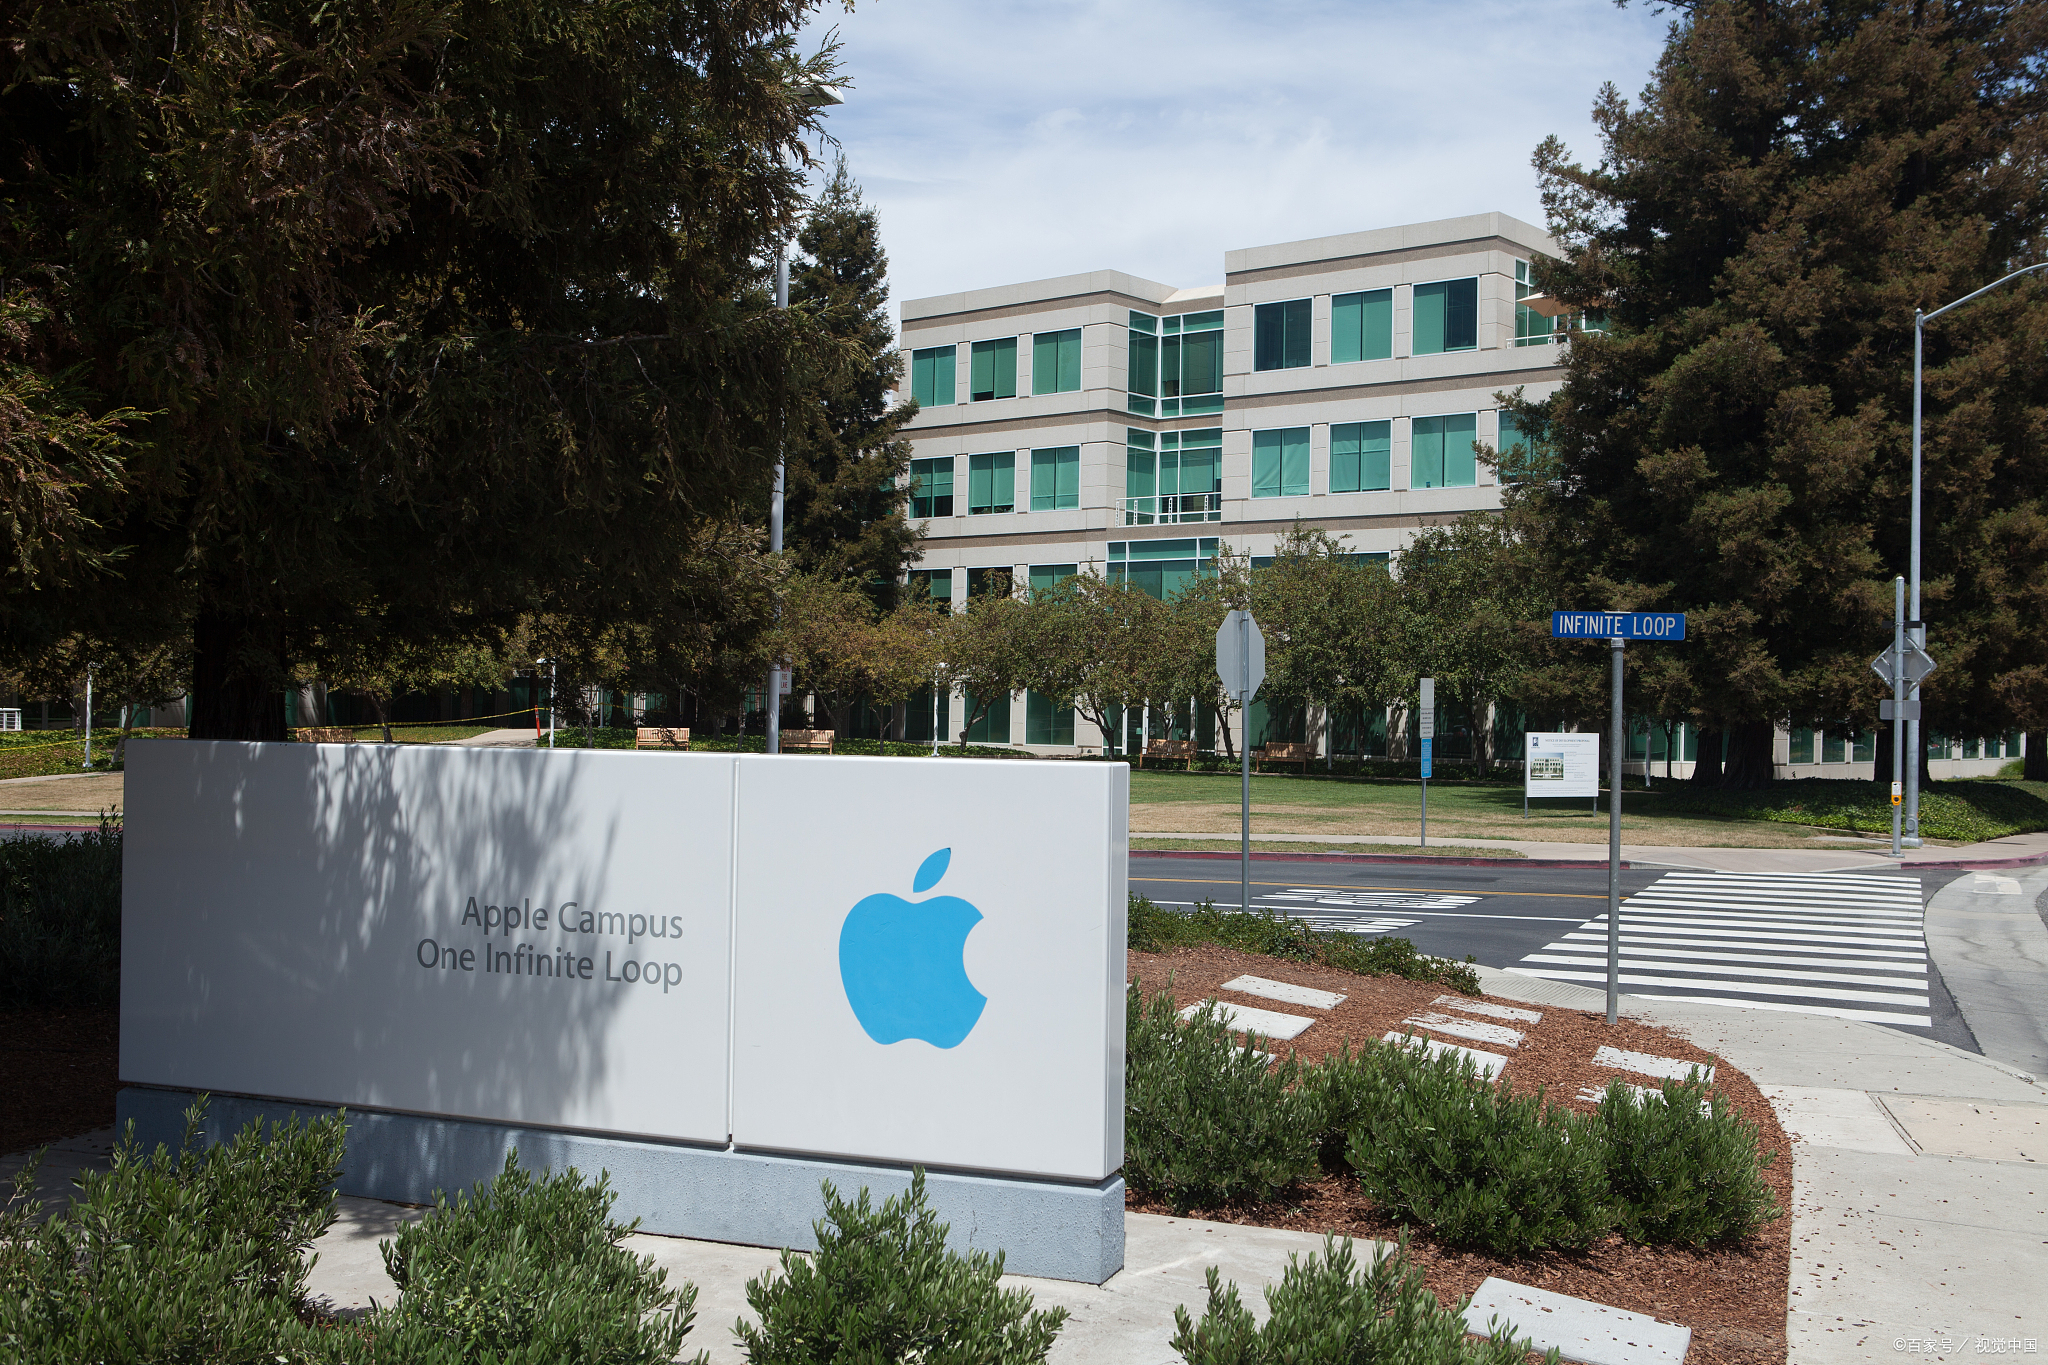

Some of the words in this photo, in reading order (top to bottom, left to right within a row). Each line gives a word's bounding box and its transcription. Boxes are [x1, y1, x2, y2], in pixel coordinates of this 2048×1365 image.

[1559, 615, 1623, 635] INFINITE
[1633, 616, 1676, 636] LOOP
[461, 896, 549, 937] Apple
[558, 901, 683, 945] Campus
[416, 938, 476, 972] One
[486, 942, 594, 980] Infinite
[605, 950, 683, 994] Loop
